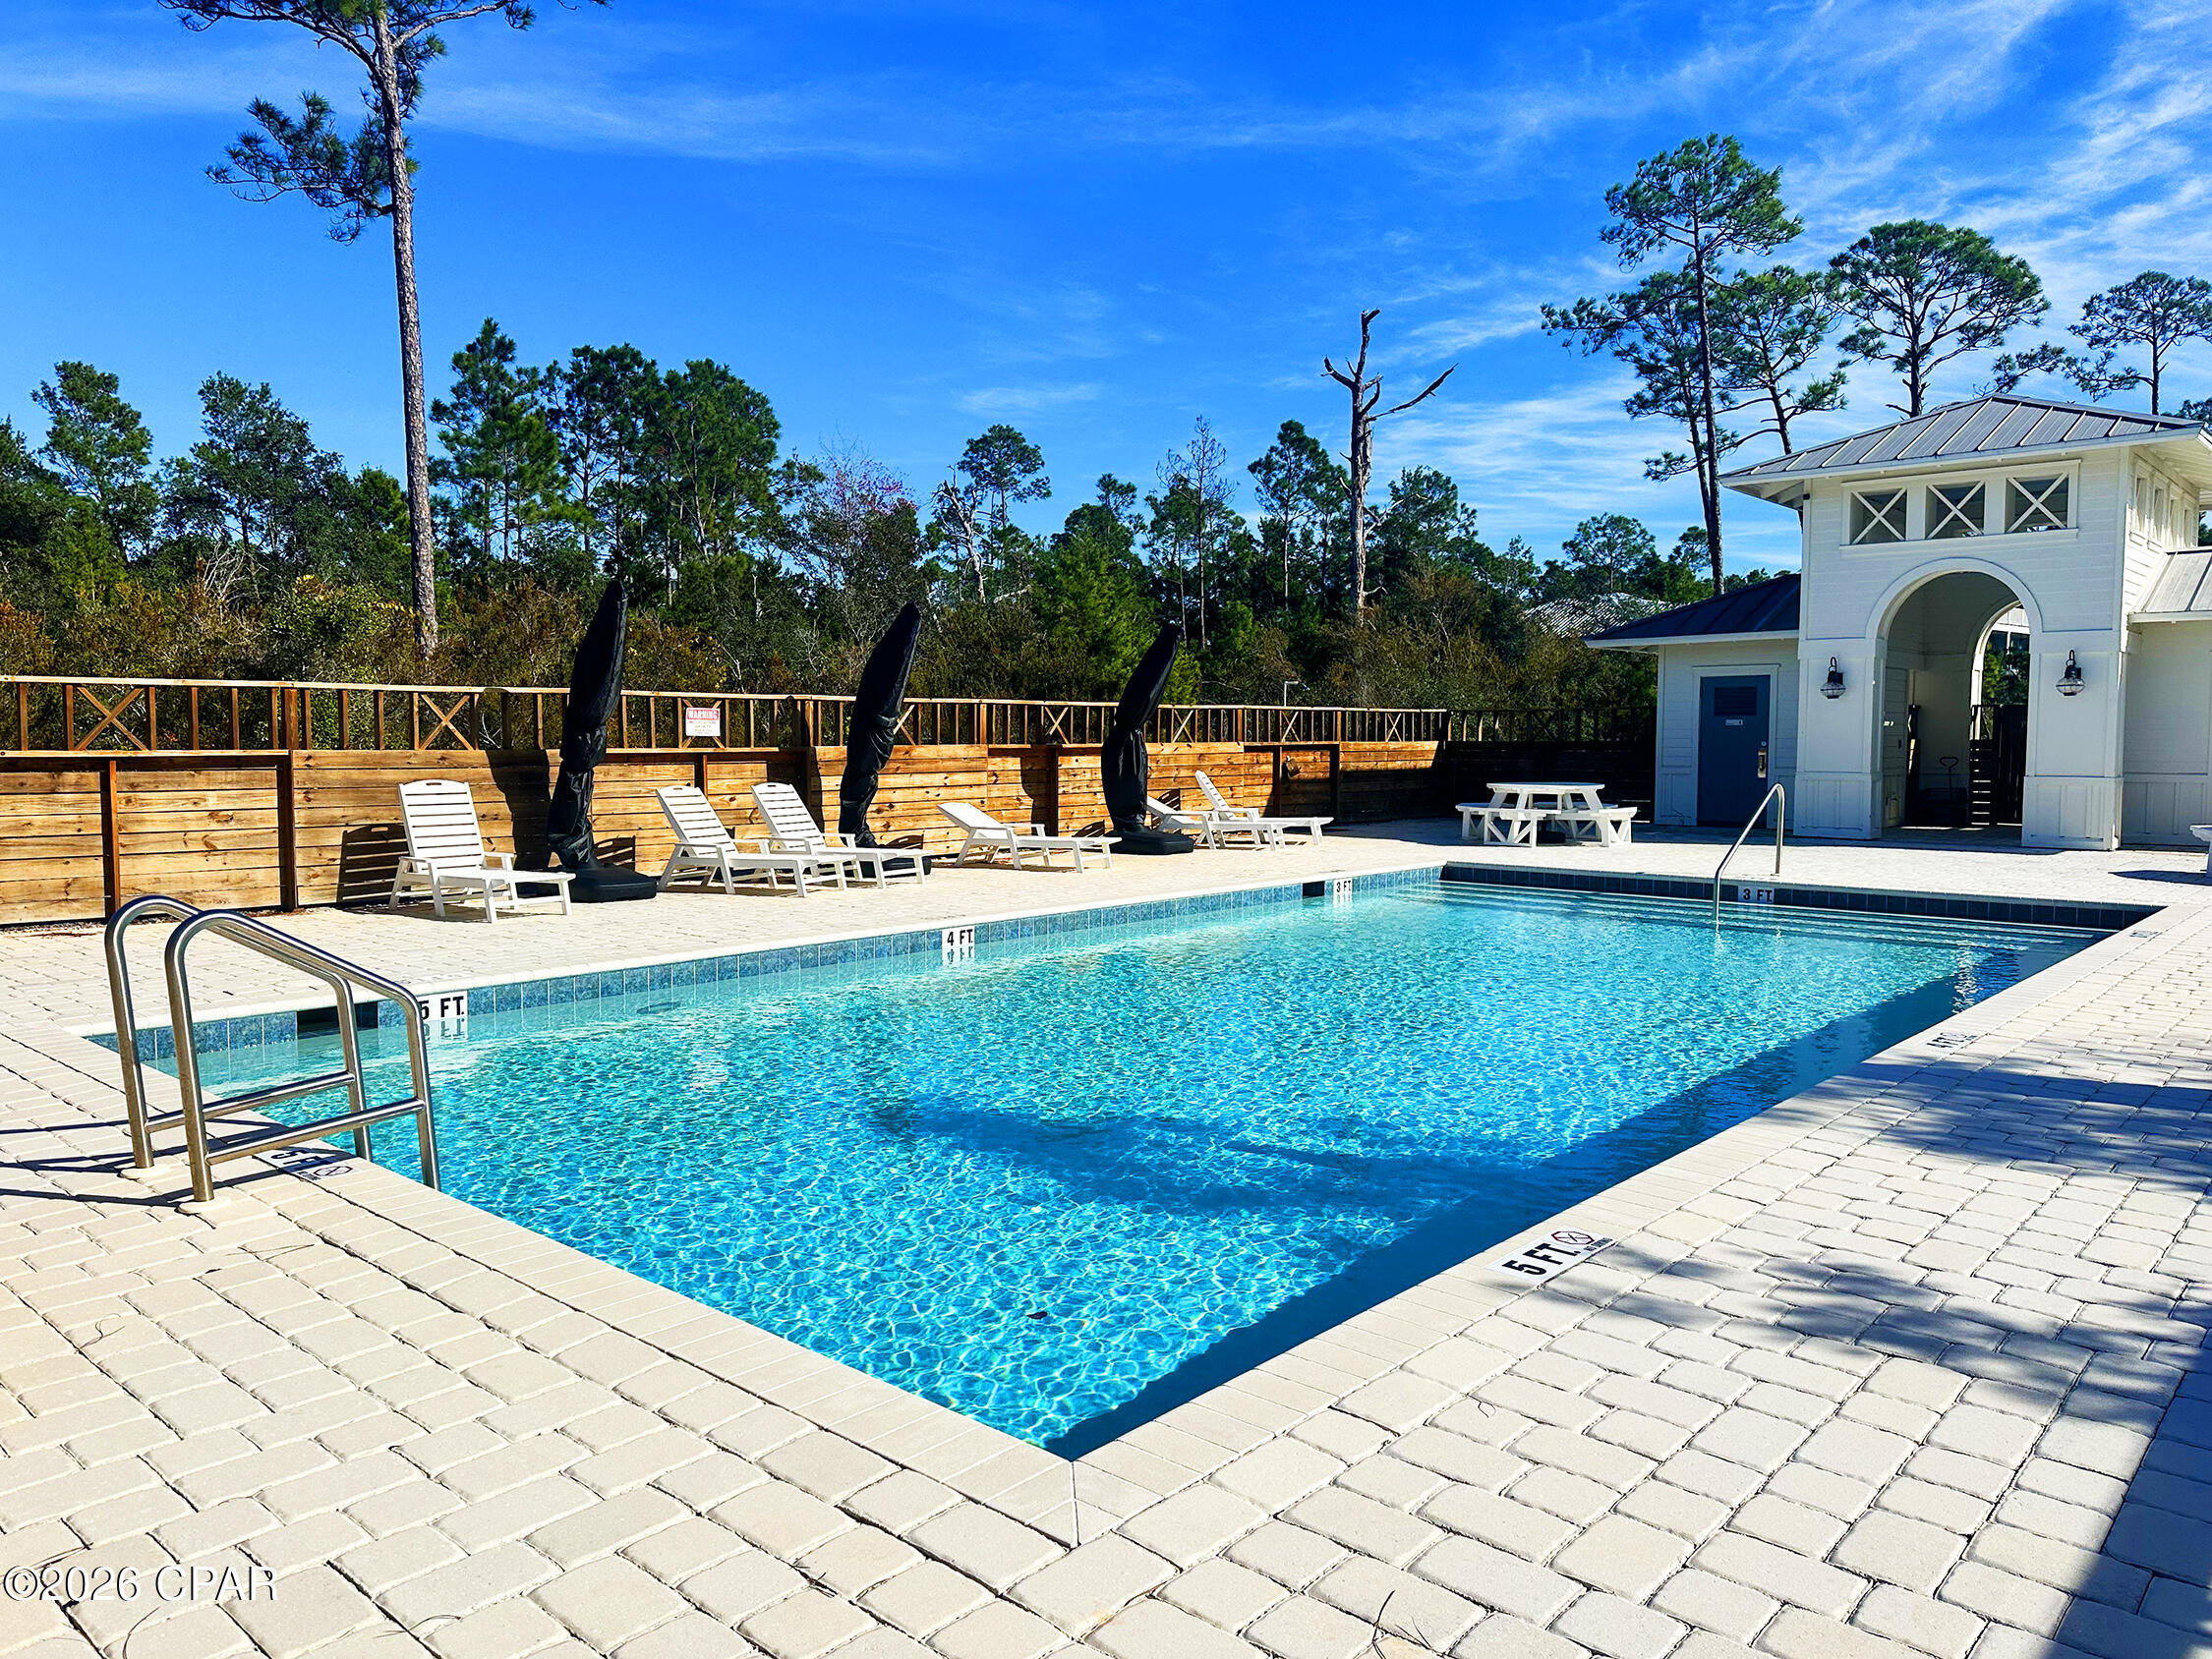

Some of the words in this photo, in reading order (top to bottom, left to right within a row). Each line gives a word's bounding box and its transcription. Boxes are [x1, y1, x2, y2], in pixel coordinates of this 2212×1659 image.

[1337, 882, 1341, 892] 3
[1743, 888, 1751, 900] 3
[947, 932, 955, 945] 4
[960, 929, 973, 944] FT.
[418, 1000, 430, 1020] 5
[440, 996, 464, 1017] FT.
[270, 1149, 311, 1160] 5
[1522, 1242, 1582, 1266] FT.
[1501, 1259, 1547, 1276] 5
